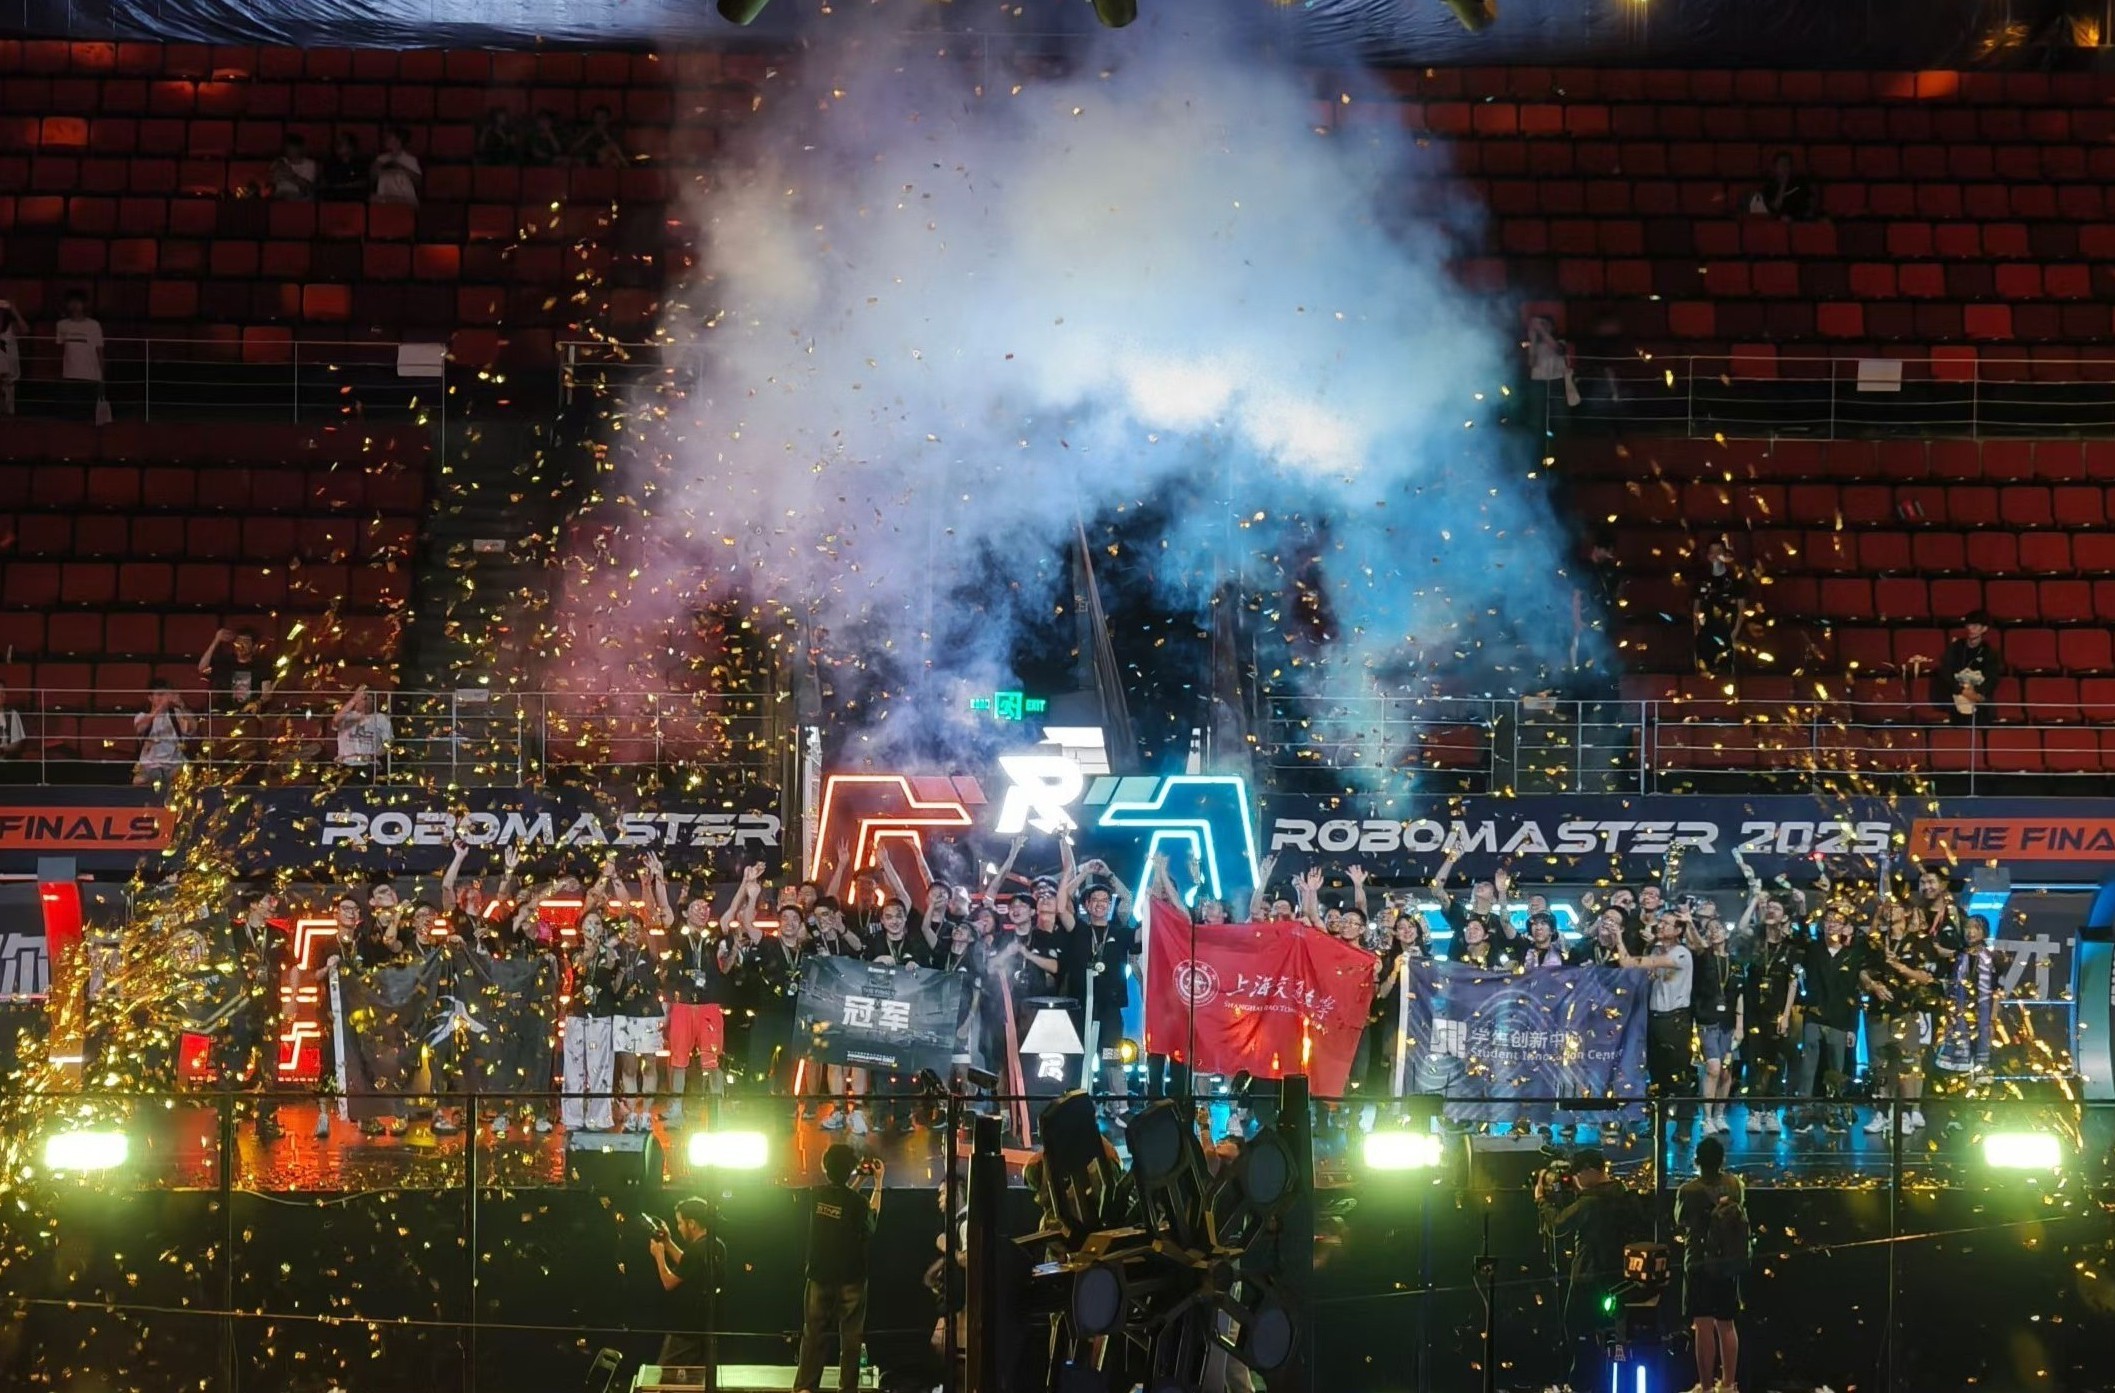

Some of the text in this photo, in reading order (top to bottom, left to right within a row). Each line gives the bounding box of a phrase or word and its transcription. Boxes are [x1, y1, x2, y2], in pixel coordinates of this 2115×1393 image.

[1025, 699, 1046, 712] EXIT
[0, 815, 160, 841] FINALS
[321, 811, 781, 847] ROBOMASTER
[1270, 818, 1892, 855] ROBOMASTER 2025
[1922, 826, 2115, 851] THE FINA
[842, 995, 911, 1031] 冠军
